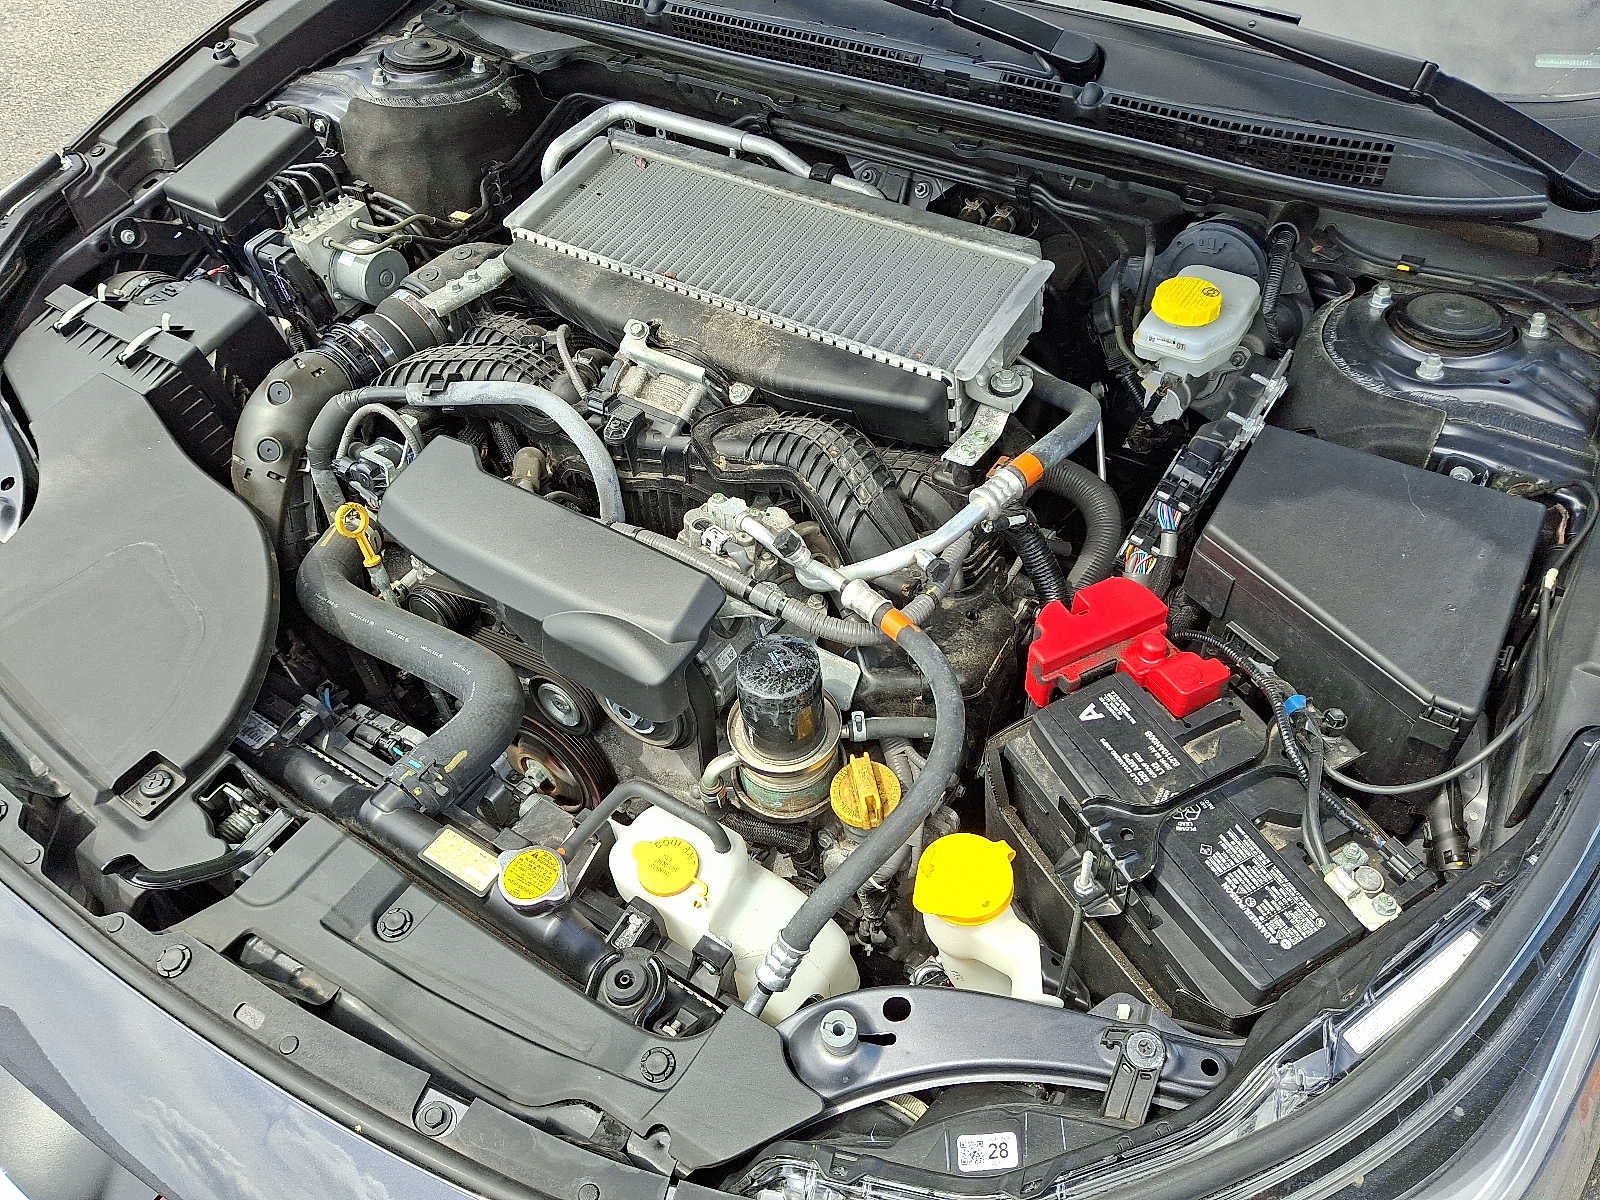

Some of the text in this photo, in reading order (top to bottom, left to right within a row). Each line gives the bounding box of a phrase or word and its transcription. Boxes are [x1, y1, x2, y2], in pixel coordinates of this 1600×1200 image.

[1079, 703, 1105, 721] A
[1100, 738, 1143, 786] COLD CRANKING AMPS
[1121, 753, 1141, 771] AMPS
[1140, 762, 1158, 778] GROUP
[988, 1142, 1009, 1160] 28
